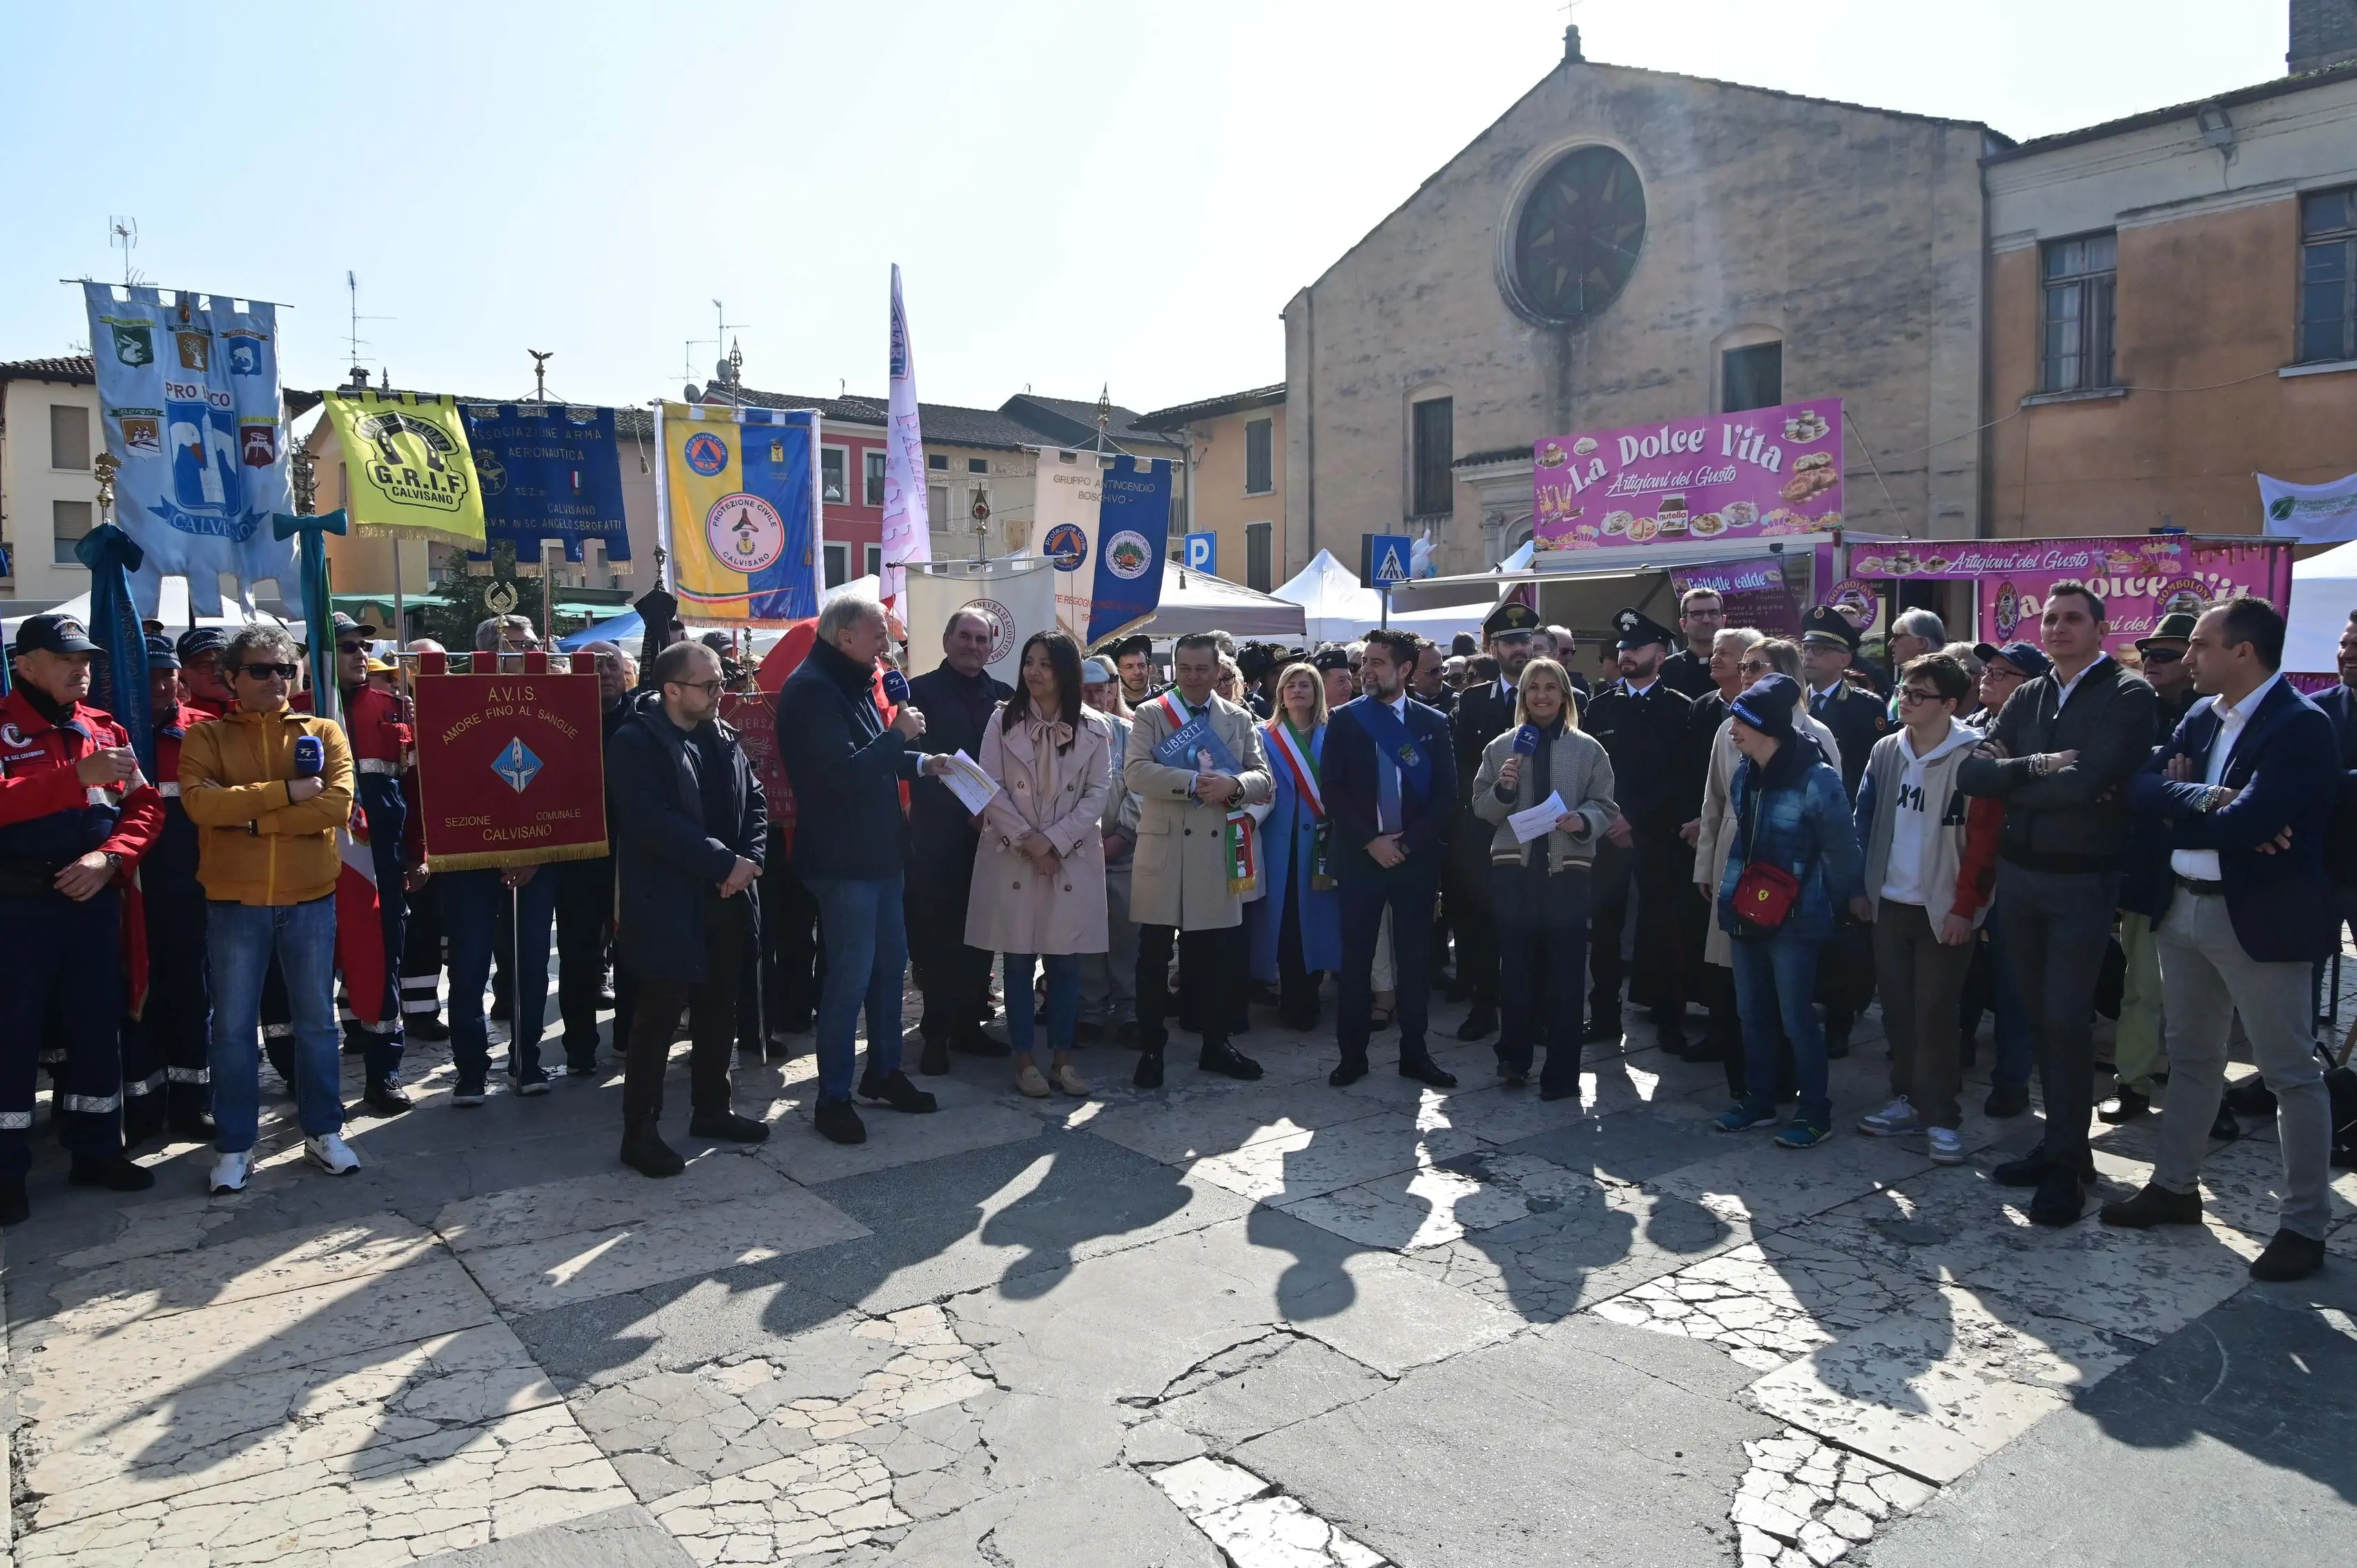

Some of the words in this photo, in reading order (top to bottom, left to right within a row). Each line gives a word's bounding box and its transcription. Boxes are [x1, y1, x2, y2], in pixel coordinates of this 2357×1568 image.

[166, 381, 197, 398] PRO
[471, 426, 559, 441] ASSOCIAZIONE
[565, 429, 602, 440] ARMA
[508, 447, 585, 461] AERONAUTICA
[1567, 456, 1608, 494] La
[1618, 425, 1706, 468] Dolce
[1721, 423, 1783, 473] Vita
[1053, 474, 1091, 486] GRUPPO
[1094, 479, 1155, 493] ANTINCENDIO
[1607, 472, 1669, 498] Artigiani
[1671, 471, 1691, 487] del
[1696, 464, 1738, 487] Gusto
[392, 485, 454, 505] CALVISANO
[1078, 491, 1126, 504] BOSCHIVO
[547, 503, 596, 516] CALVISANO
[712, 499, 755, 527] PROTEZIONE
[757, 504, 777, 528] CIVILE
[1659, 511, 1687, 521] nutella
[1045, 525, 1077, 546] Protezione
[1077, 532, 1087, 550] Civile
[723, 551, 770, 567] CALVISANO
[1190, 539, 1209, 568] P
[1947, 552, 2015, 576] Artigiani
[2017, 554, 2040, 568] del
[2043, 550, 2089, 569] Gusto
[1734, 572, 1766, 590] calde
[1828, 581, 1874, 603] BOMBOLONI
[1001, 611, 1009, 620] 22
[2124, 616, 2153, 631] del
[1003, 621, 1013, 650] AGOSTO
[991, 649, 1005, 661] 1864
[488, 686, 537, 701] A.V.I.S.
[442, 712, 482, 746] AMORE
[485, 705, 514, 719] FINO
[518, 706, 532, 716] AL
[537, 709, 579, 739] SANGUE
[1161, 722, 1201, 755] LIBERTY
[445, 815, 492, 828] SEZIONE
[536, 808, 581, 821] COMUNALE
[483, 824, 552, 841] CALVISANO
